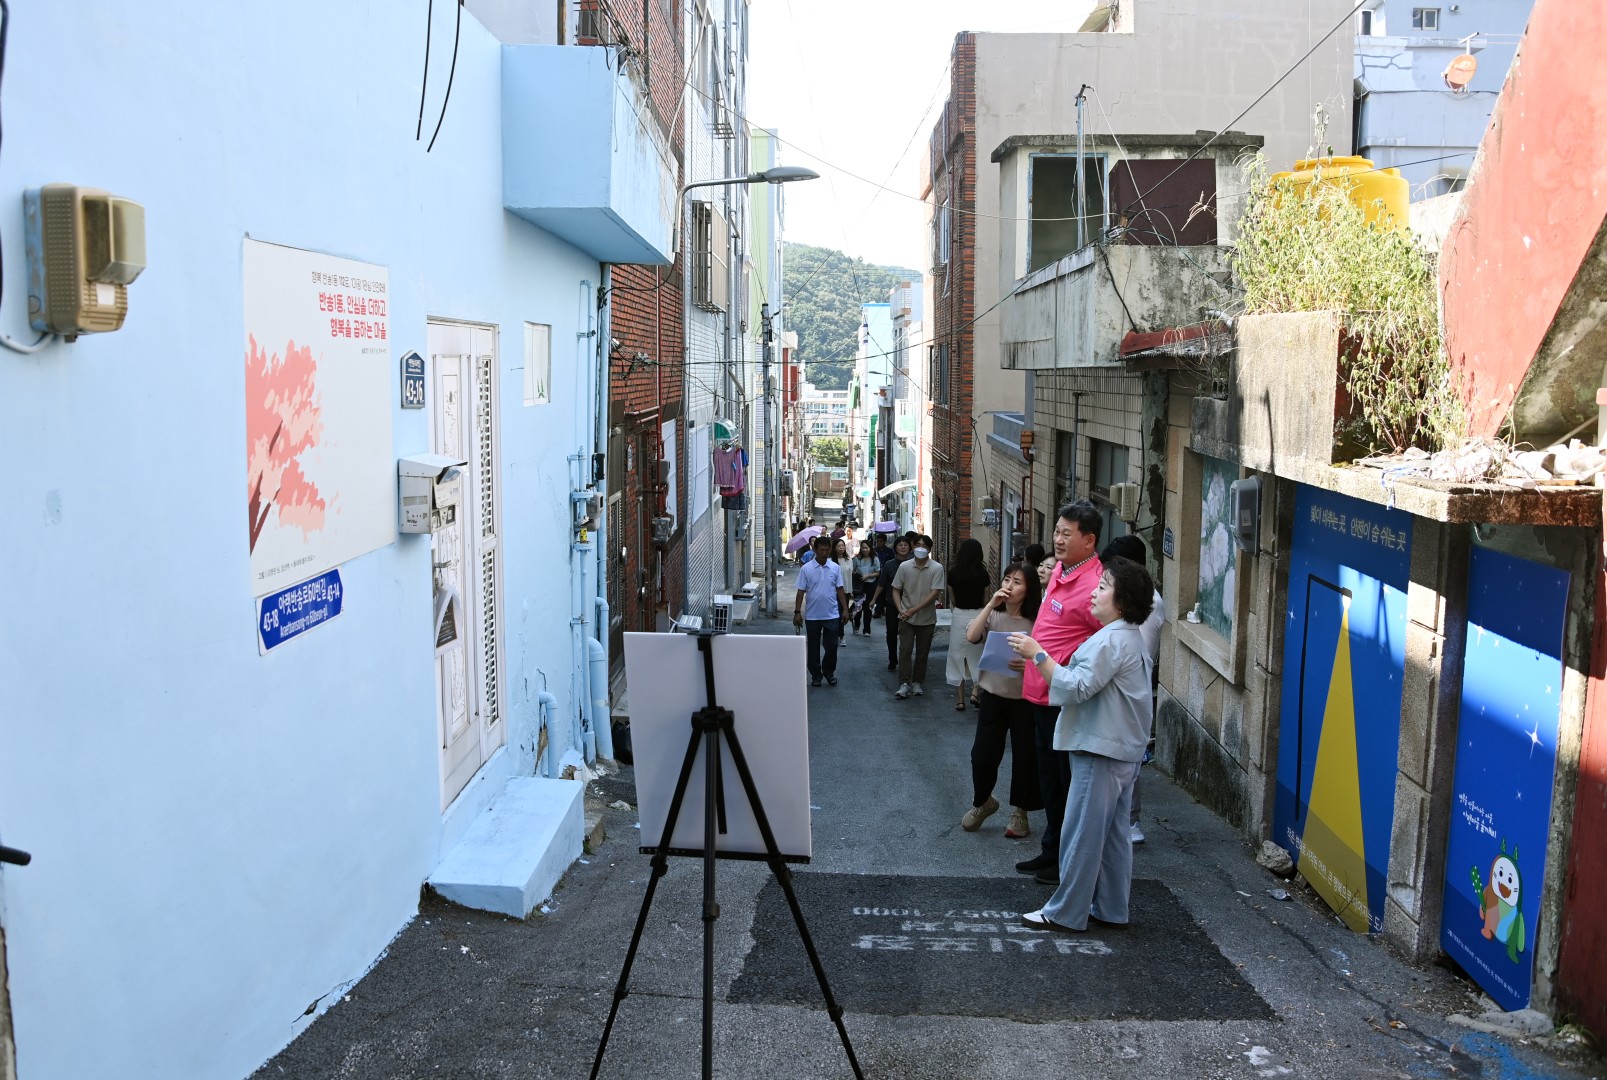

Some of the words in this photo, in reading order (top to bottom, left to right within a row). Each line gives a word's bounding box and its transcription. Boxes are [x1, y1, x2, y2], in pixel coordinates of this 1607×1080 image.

[319, 292, 346, 314] 반송1동,
[347, 295, 367, 315] 안심을
[368, 298, 386, 316] 더하고
[330, 317, 352, 338] 행복을
[353, 320, 373, 339] 곱하는
[374, 321, 387, 340] 마을
[406, 379, 423, 401] 43-16
[1338, 514, 1346, 534] 곳
[1350, 517, 1371, 541] 안전이
[1396, 531, 1406, 552] 곳
[263, 608, 279, 632] 43-18
[278, 577, 326, 615] 아랫반송로60번길
[327, 582, 340, 602] 43-14
